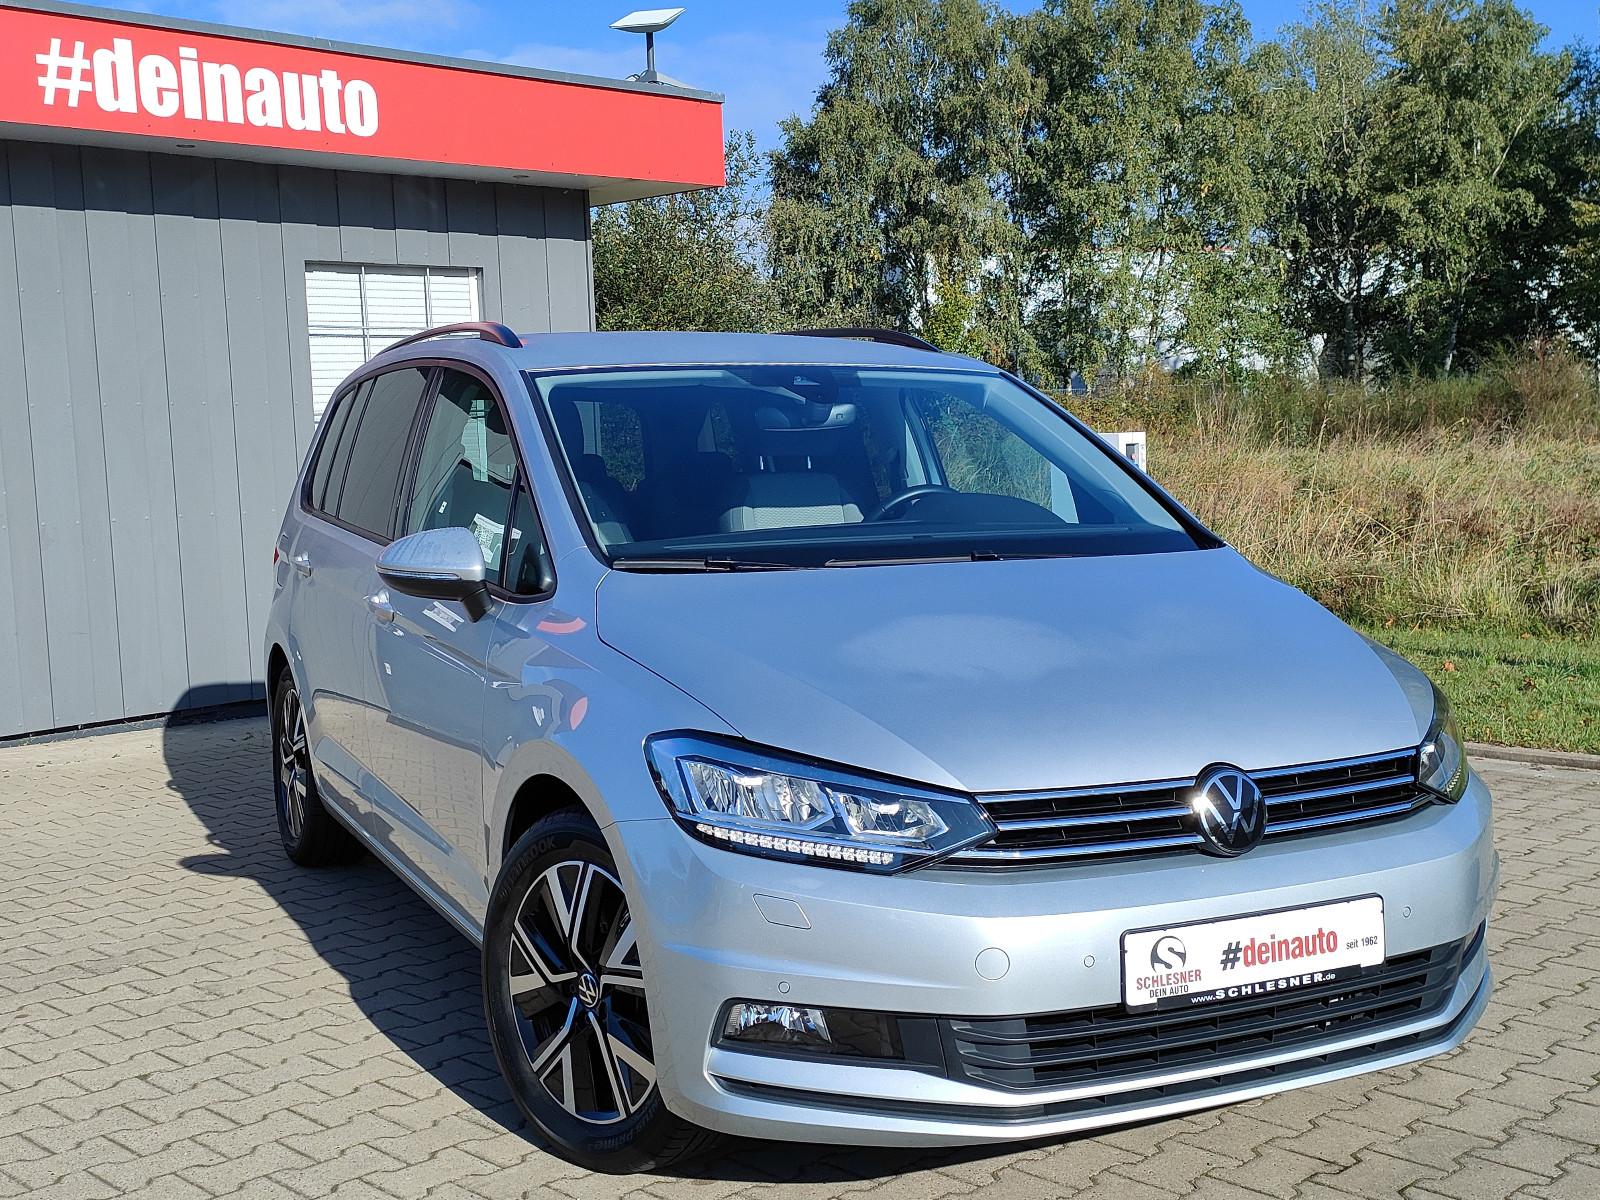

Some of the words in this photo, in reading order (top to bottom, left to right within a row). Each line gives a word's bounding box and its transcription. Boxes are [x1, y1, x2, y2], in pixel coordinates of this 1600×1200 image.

[35, 37, 379, 138] #deinauto
[1219, 927, 1338, 971] #deinauto
[1346, 940, 1359, 950] seit
[1360, 935, 1378, 948] 1962
[1136, 969, 1202, 991] SCHLESNER
[1149, 986, 1168, 999] DEIN
[1169, 984, 1189, 996] AUTO
[1190, 972, 1336, 1004] www.SCHLESNER.de
